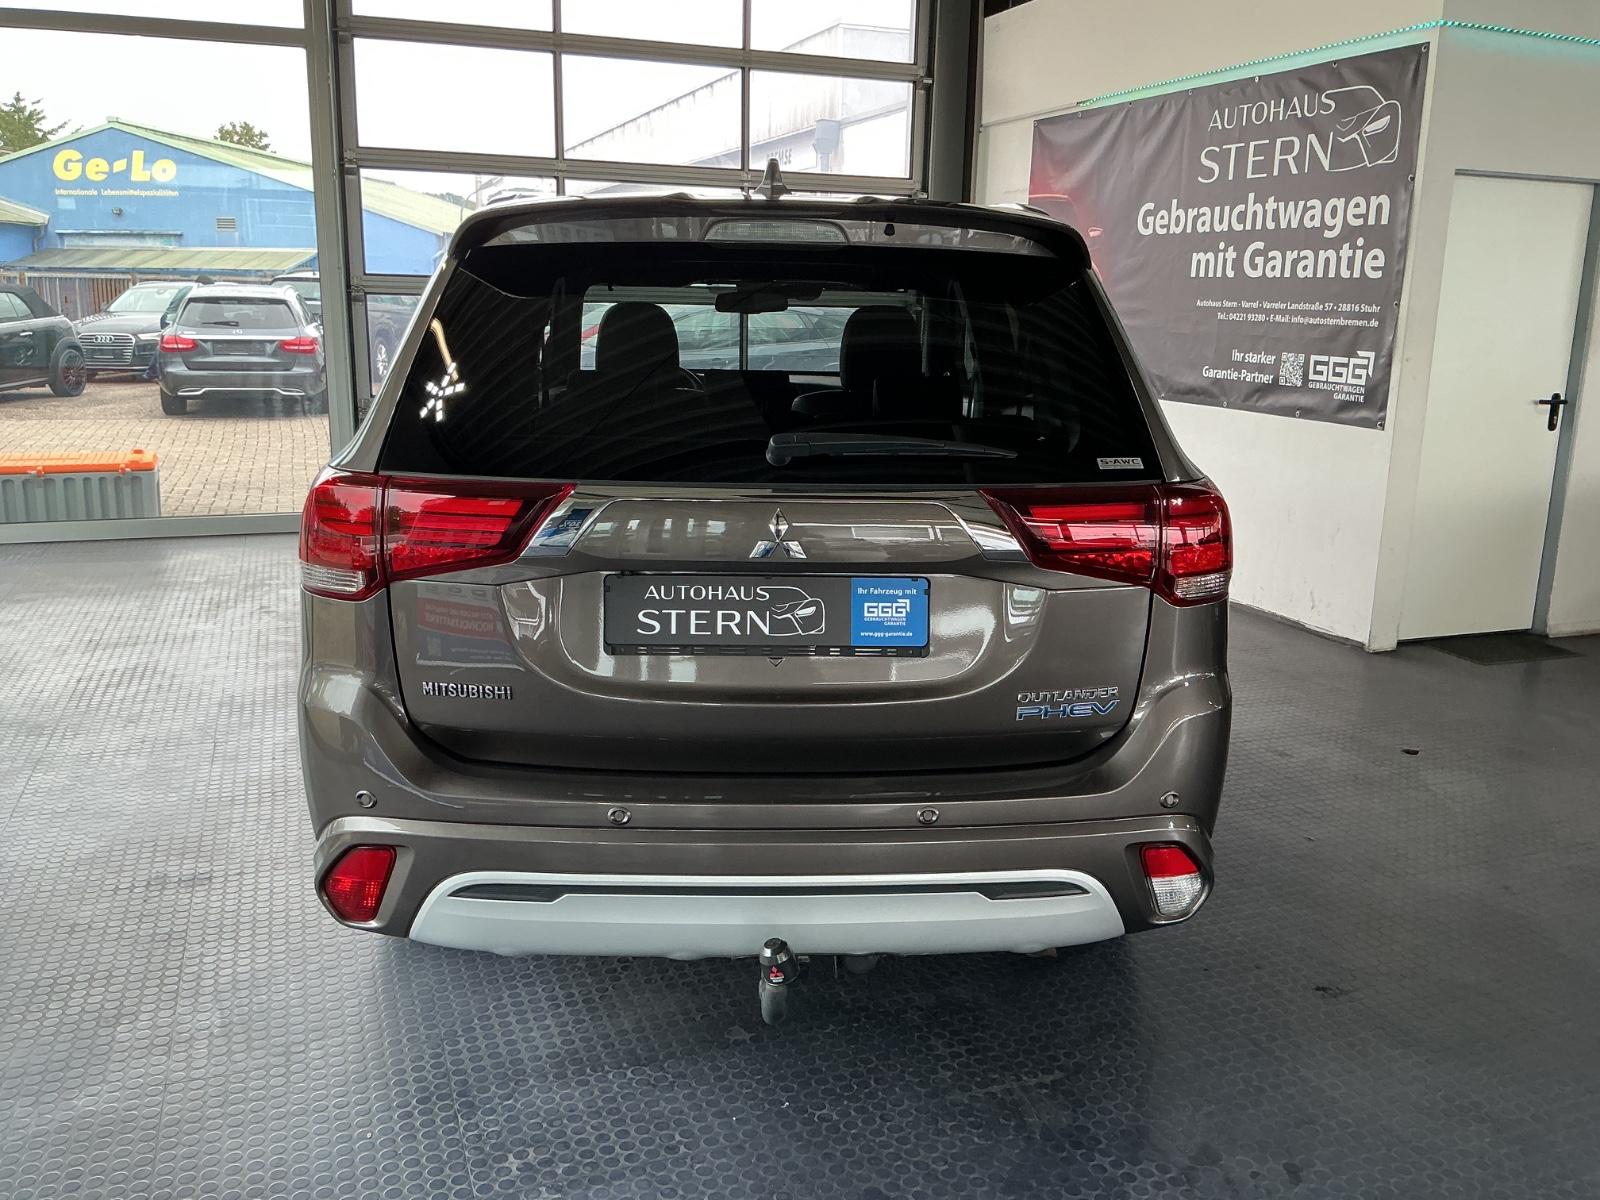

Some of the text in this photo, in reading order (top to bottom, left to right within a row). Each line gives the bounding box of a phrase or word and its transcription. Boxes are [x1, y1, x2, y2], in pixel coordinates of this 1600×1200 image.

[1208, 92, 1336, 132] AUTOHAUS
[53, 149, 177, 182] Ge-Lo
[1198, 131, 1334, 183] STERN
[54, 188, 98, 196] Internationale
[1137, 192, 1391, 238] Gebrauchtwagen
[1190, 237, 1386, 279] mit Garantie
[1196, 299, 1381, 313] Autohaus Stern Varrel Varreler Landstraße 57 28816 Stuhr
[1229, 313, 1246, 321] 04221
[1247, 313, 1266, 322] 93280
[1269, 314, 1291, 323] E-Mail:
[1291, 315, 1379, 328] info@autosternbremen.de
[1231, 349, 1276, 365] Ihr starker
[1202, 365, 1274, 384] Garantie-Partner
[1308, 354, 1369, 386] GGG
[1308, 381, 1365, 394] GEBRAUCHTWAGEN
[1333, 391, 1365, 403] GARANTIE
[644, 585, 770, 601] AUTOHAUS
[857, 587, 917, 596] Ihr Fahrzeug mit
[863, 602, 906, 617] GGG
[636, 609, 770, 636] STERN
[422, 681, 511, 700] MITSUBISHI
[1017, 686, 1119, 703] OUTLANDER
[1016, 699, 1121, 721] PHEV
